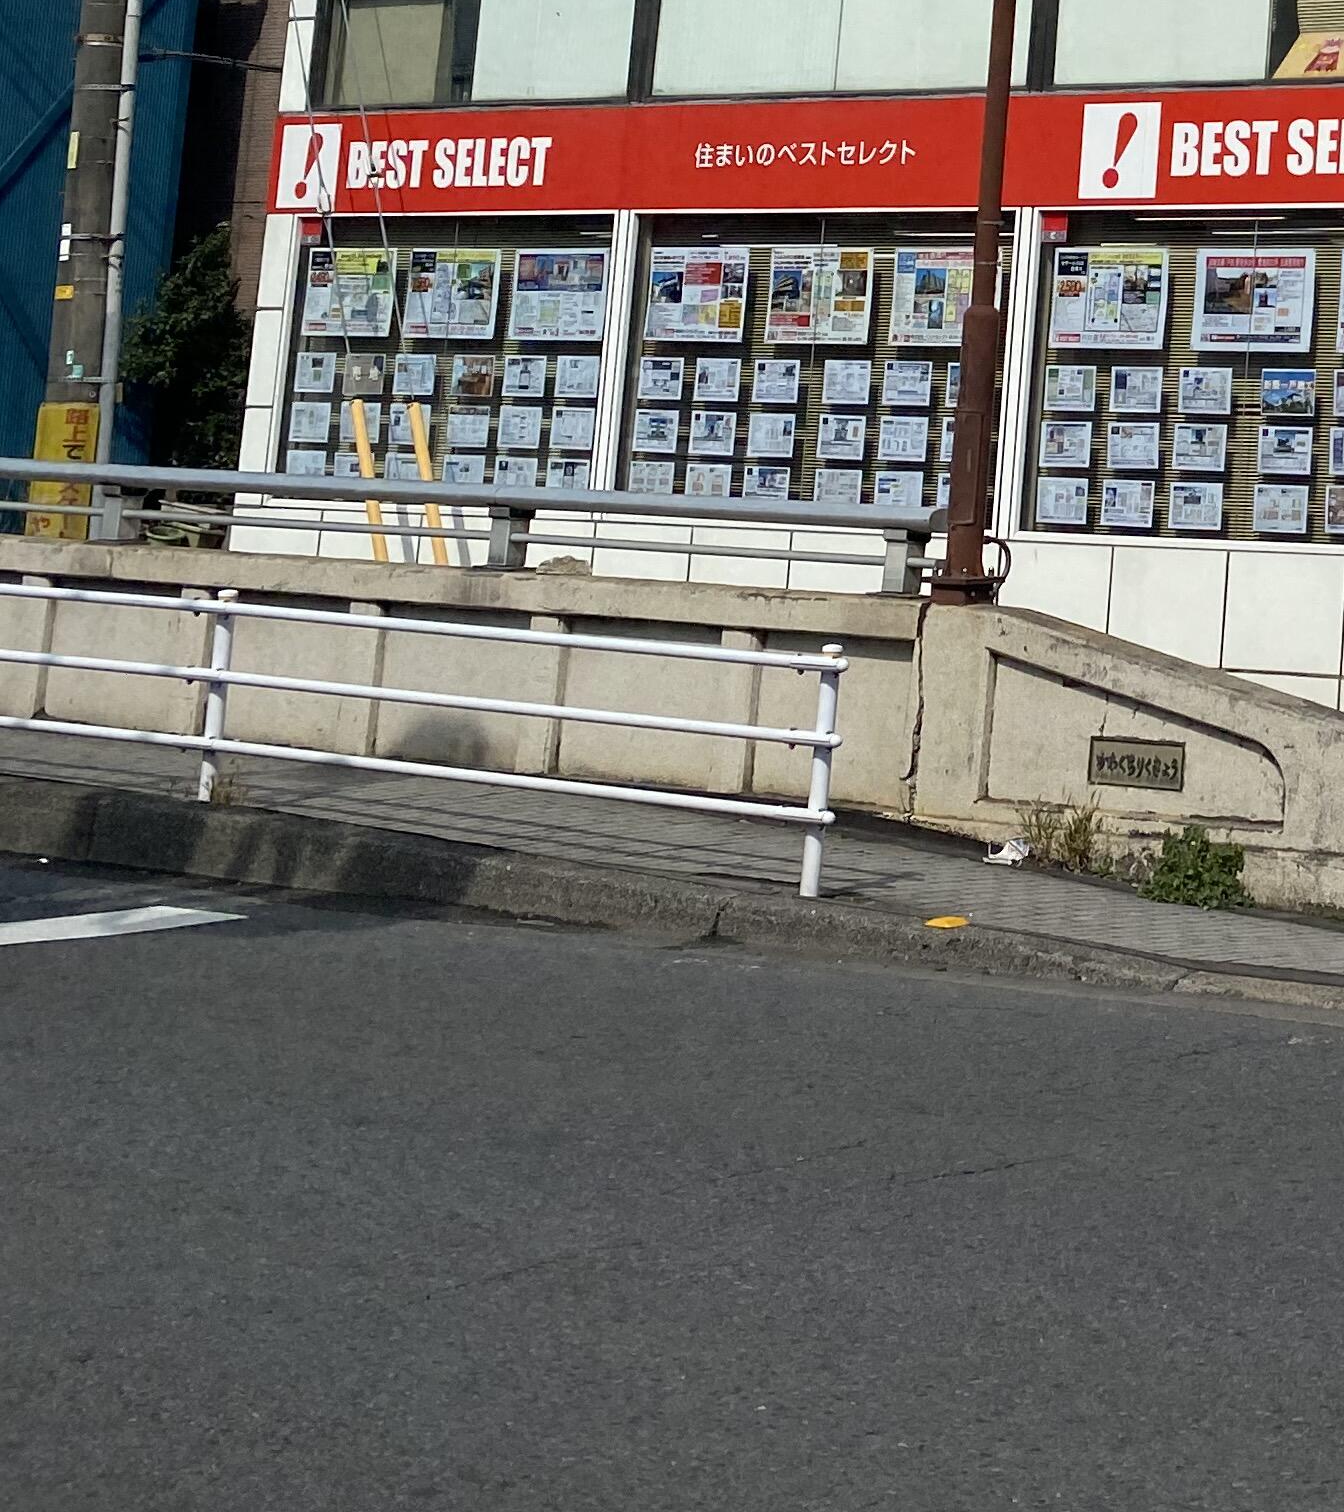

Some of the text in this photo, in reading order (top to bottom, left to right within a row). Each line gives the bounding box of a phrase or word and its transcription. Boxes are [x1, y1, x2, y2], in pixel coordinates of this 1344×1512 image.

[345, 136, 554, 189] BEST SELECT
[694, 138, 917, 170] 住まいのベストセレクト
[1169, 119, 1279, 178] BEST
